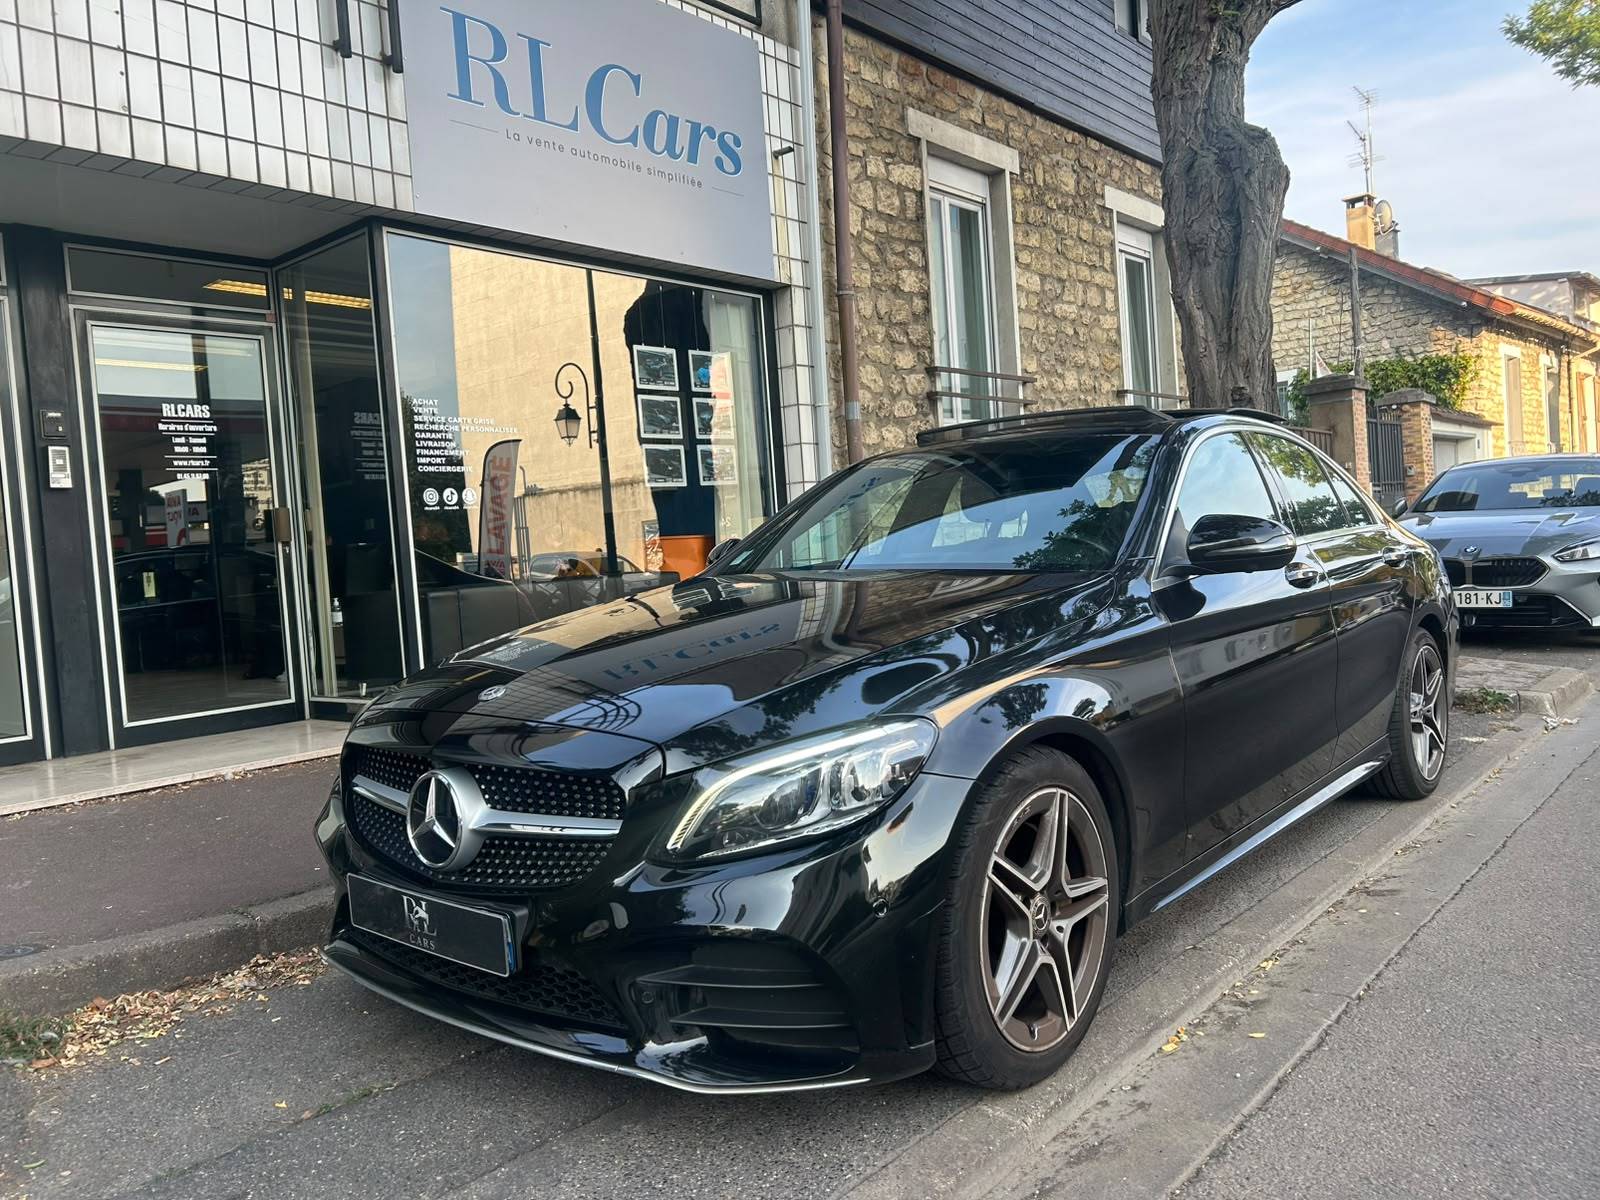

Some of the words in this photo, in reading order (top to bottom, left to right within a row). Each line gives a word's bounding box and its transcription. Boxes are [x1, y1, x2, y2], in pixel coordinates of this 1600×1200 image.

[505, 128, 521, 142] La
[527, 135, 565, 153] vente
[570, 147, 643, 173] automobile
[646, 165, 704, 189] simplifiée
[412, 398, 439, 406] ACHAT
[162, 403, 210, 418] RLCARS
[413, 415, 446, 423] SERVICE
[473, 417, 496, 425] GRISE
[413, 423, 460, 432] RECHERCHE
[415, 440, 457, 448] LIVRAISON
[416, 448, 470, 456] FINANCEMENT
[417, 465, 473, 473] CONCIERGERIE
[1457, 592, 1501, 604] 181-KJ
[409, 934, 435, 950] CARS
